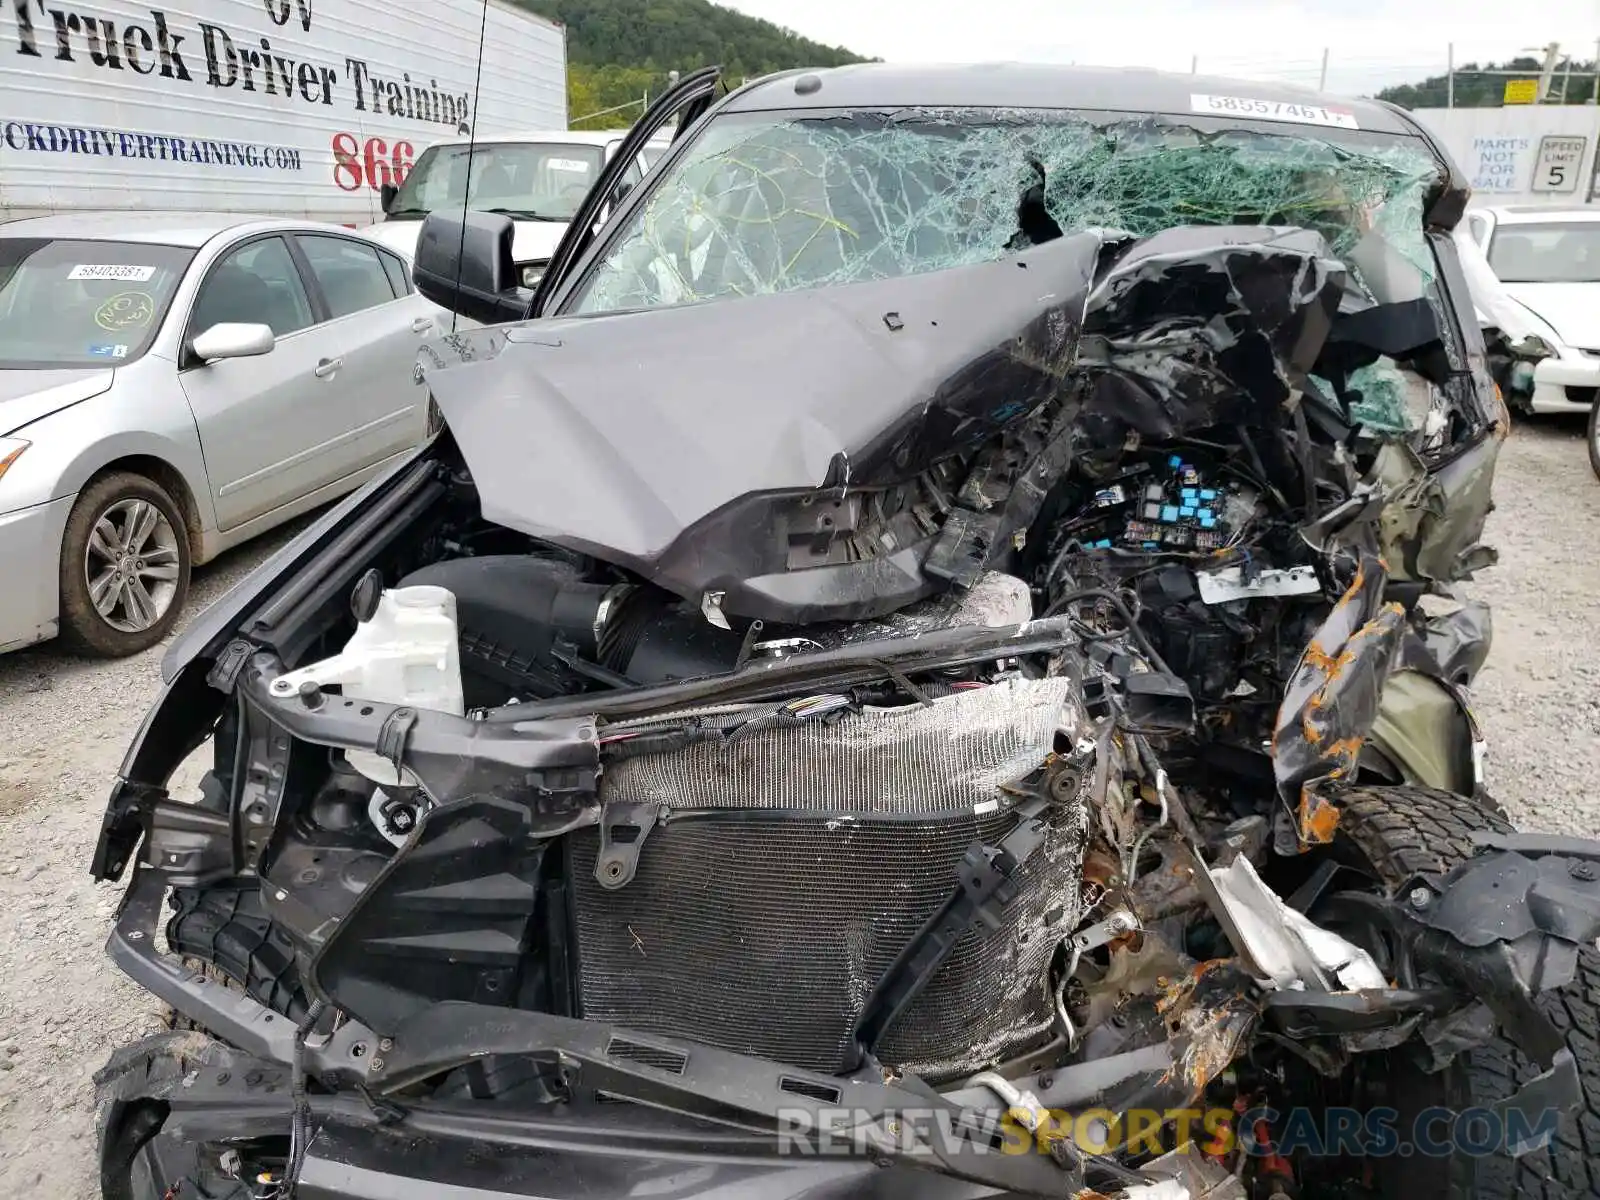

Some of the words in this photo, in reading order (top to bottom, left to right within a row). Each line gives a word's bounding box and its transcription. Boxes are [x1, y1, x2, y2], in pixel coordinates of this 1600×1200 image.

[0, 0, 193, 81] Truck
[198, 22, 337, 105] Driver
[346, 57, 470, 136] Training
[1207, 96, 1330, 121] 58557461
[0, 121, 301, 170] CKDRIVERTRAINING.COM
[1472, 138, 1529, 150] PARTS
[1544, 141, 1582, 151] SPEED
[1480, 151, 1518, 162] NOT
[1544, 154, 1576, 162] LIMIT
[1479, 164, 1516, 176] FOR
[1547, 165, 1565, 186] 5
[1472, 178, 1515, 189] SALE
